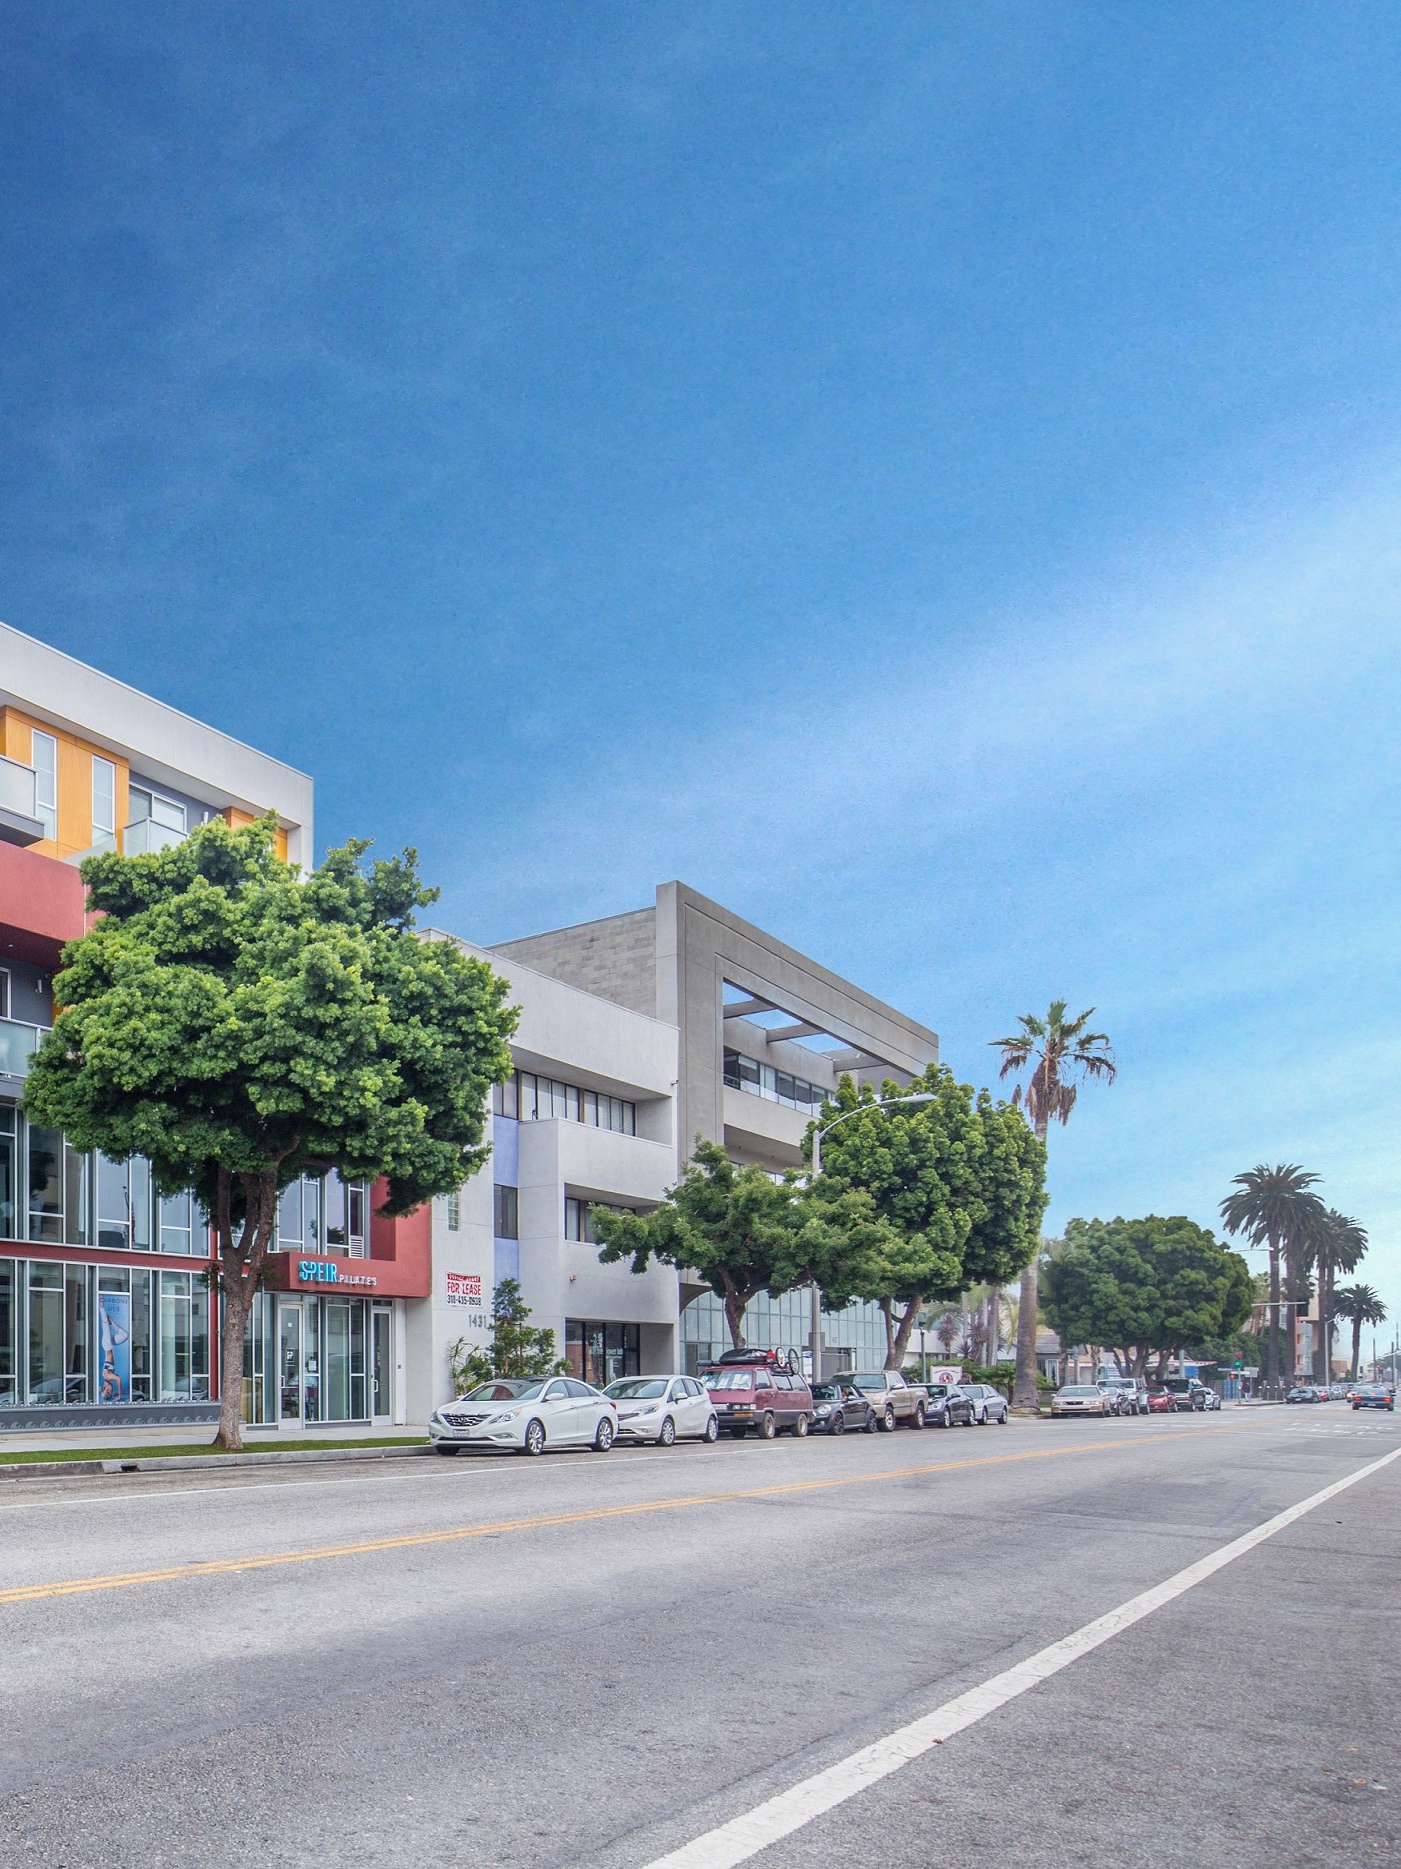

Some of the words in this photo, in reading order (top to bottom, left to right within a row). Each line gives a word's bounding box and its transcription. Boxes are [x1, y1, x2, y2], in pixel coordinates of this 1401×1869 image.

[299, 1260, 338, 1283] SPEIR
[447, 1281, 460, 1294] FOR
[462, 1283, 481, 1295] LEASE
[468, 1314, 487, 1328] 1431
